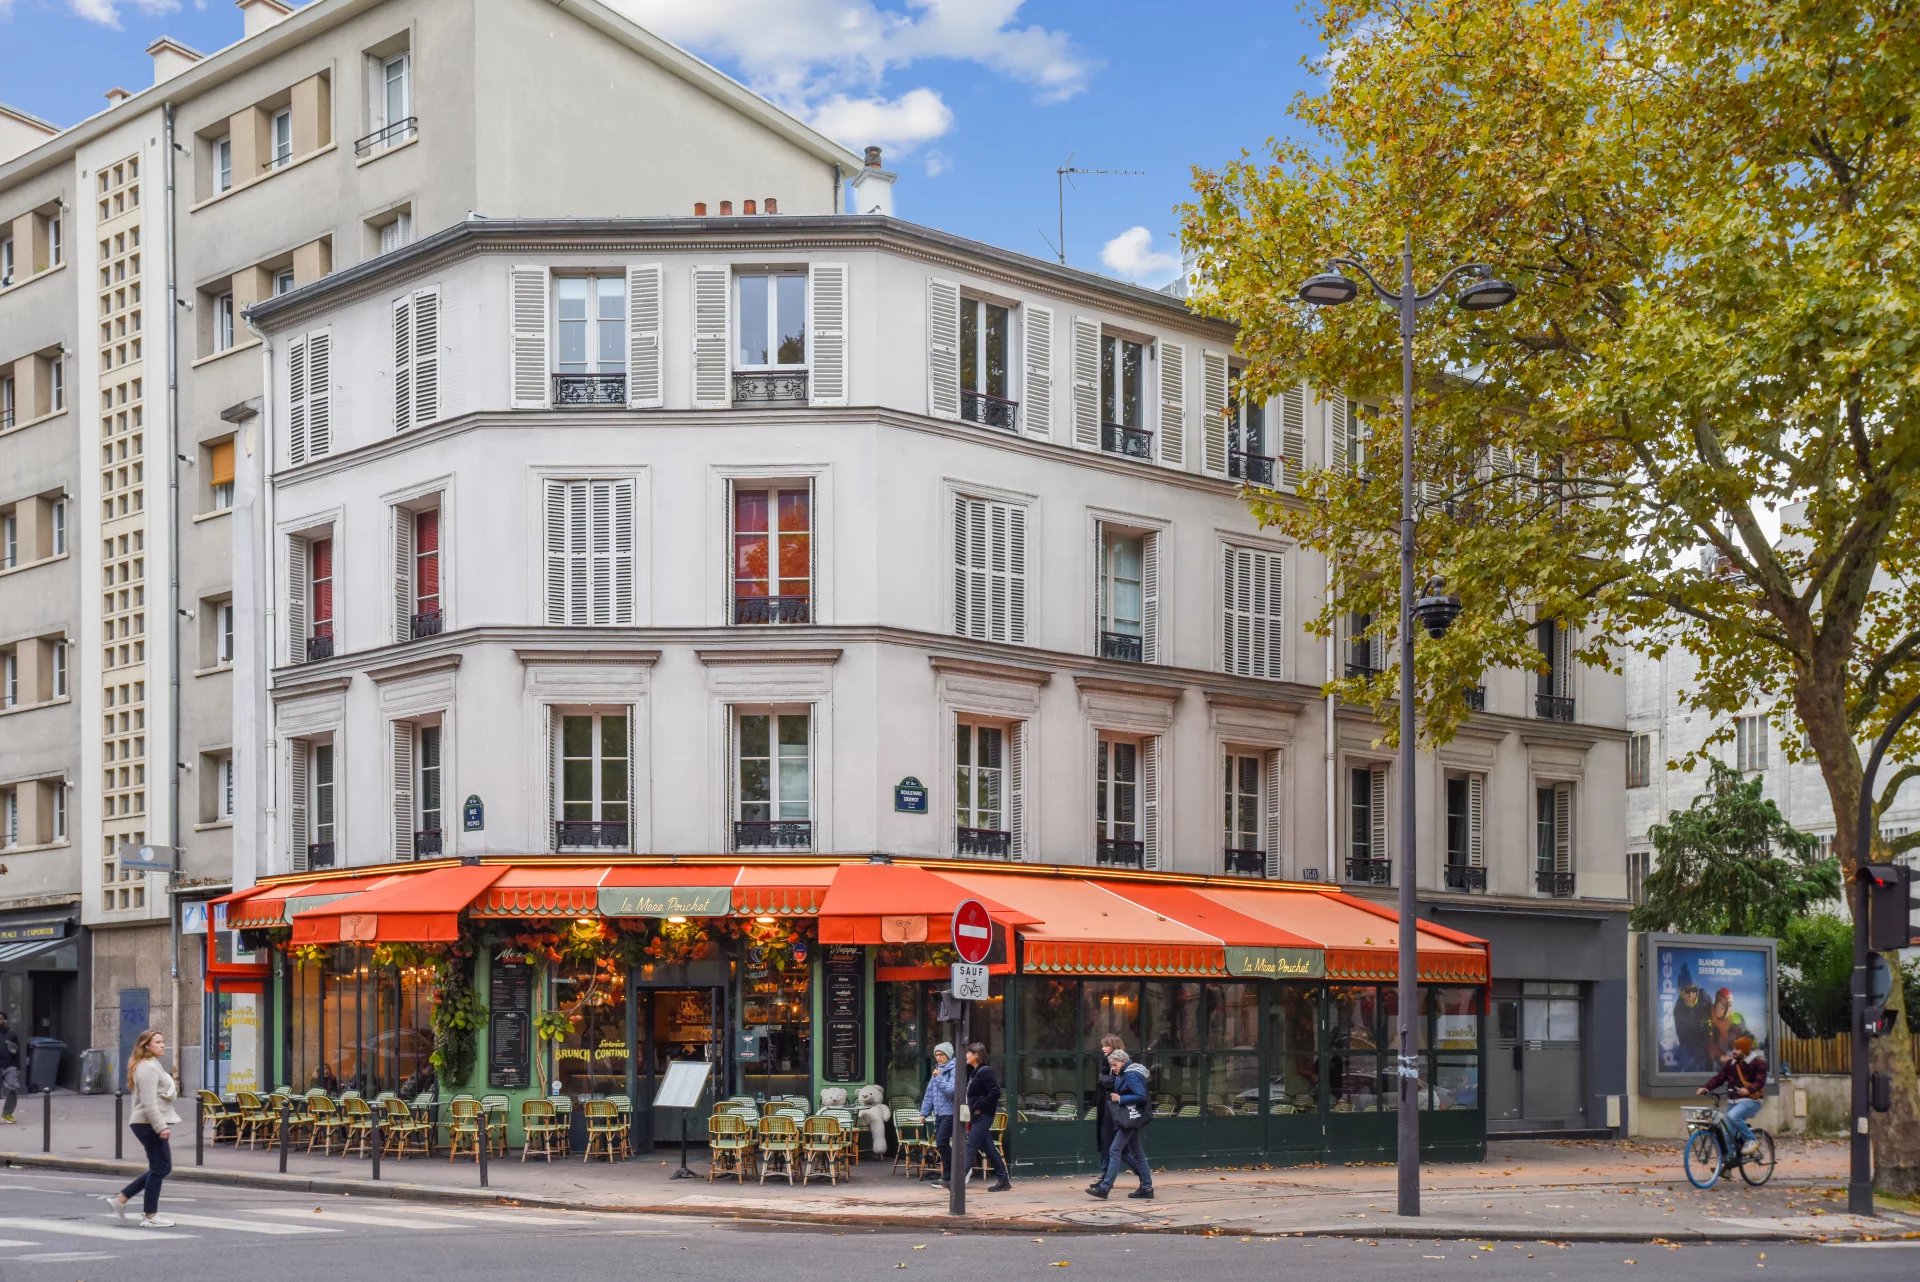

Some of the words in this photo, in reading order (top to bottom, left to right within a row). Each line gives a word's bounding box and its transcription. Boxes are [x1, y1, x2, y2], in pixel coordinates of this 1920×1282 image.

[1304, 869, 1316, 878] 168
[620, 897, 632, 912] La
[667, 896, 710, 912] Pouchet
[960, 966, 983, 976] SAUF
[1242, 957, 1252, 972] La
[1277, 957, 1310, 973] Pouchet
[599, 1039, 626, 1048] Service
[555, 1049, 591, 1063] BRUNCH
[594, 1049, 630, 1060] CONTINU
